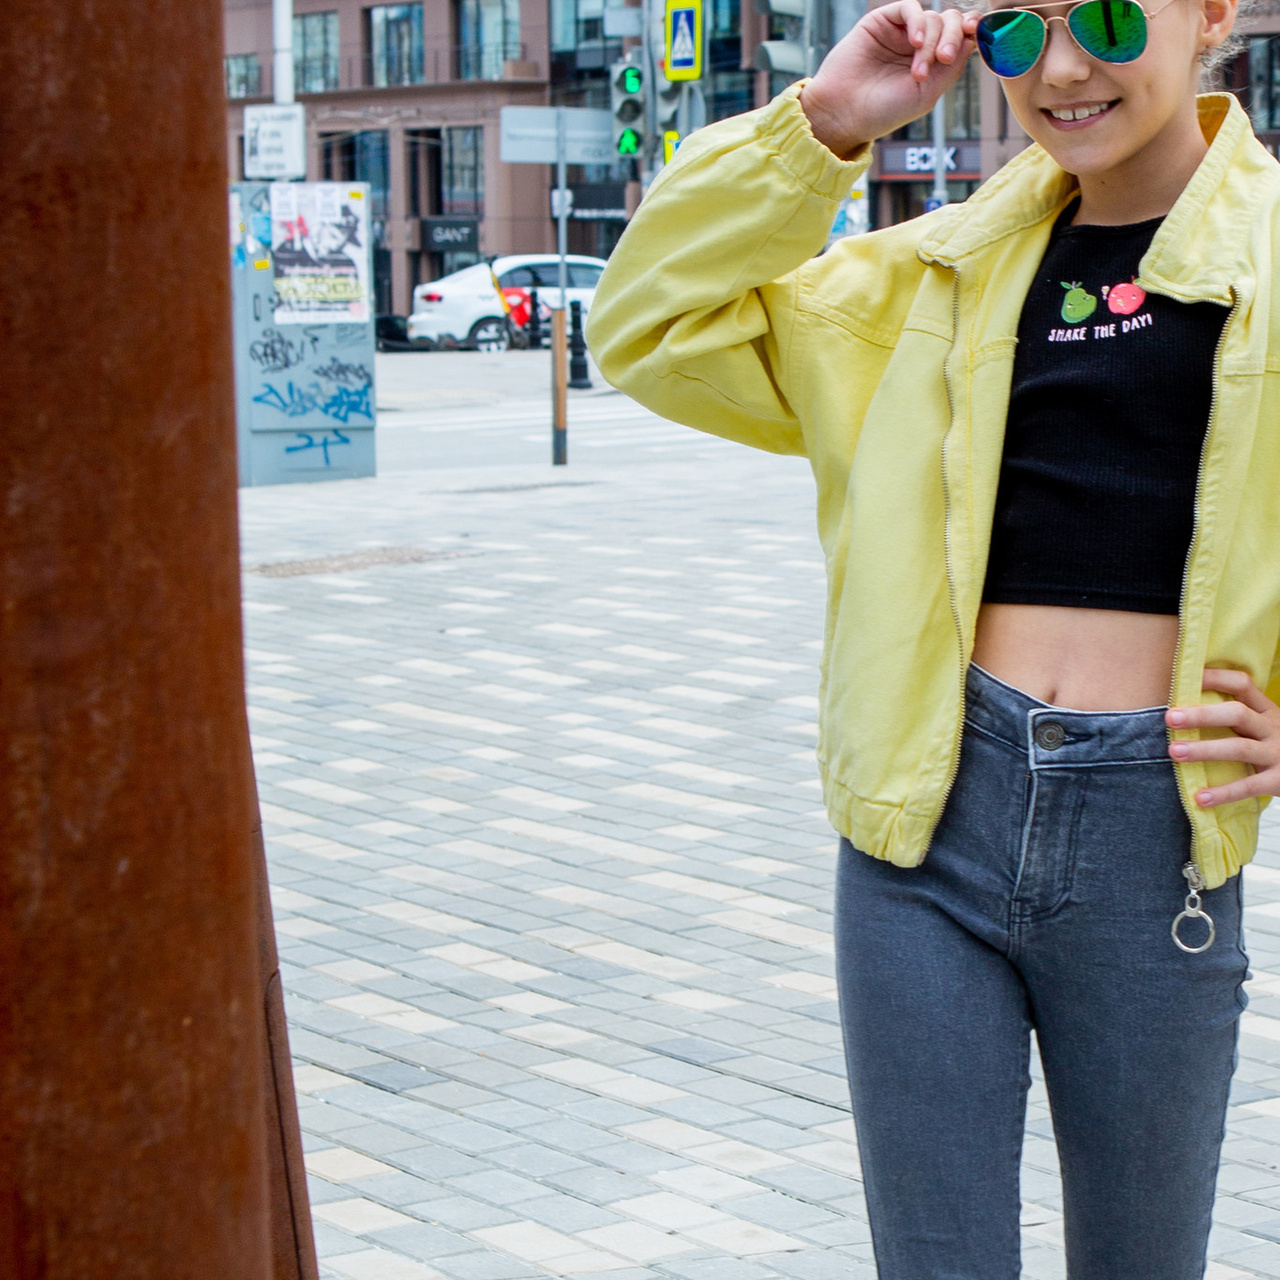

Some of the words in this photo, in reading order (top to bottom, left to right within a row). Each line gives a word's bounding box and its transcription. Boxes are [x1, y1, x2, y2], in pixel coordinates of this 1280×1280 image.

[905, 147, 957, 171] BOK
[432, 226, 471, 243] GANT
[1047, 326, 1088, 342] SHAKE
[1093, 323, 1117, 340] THE
